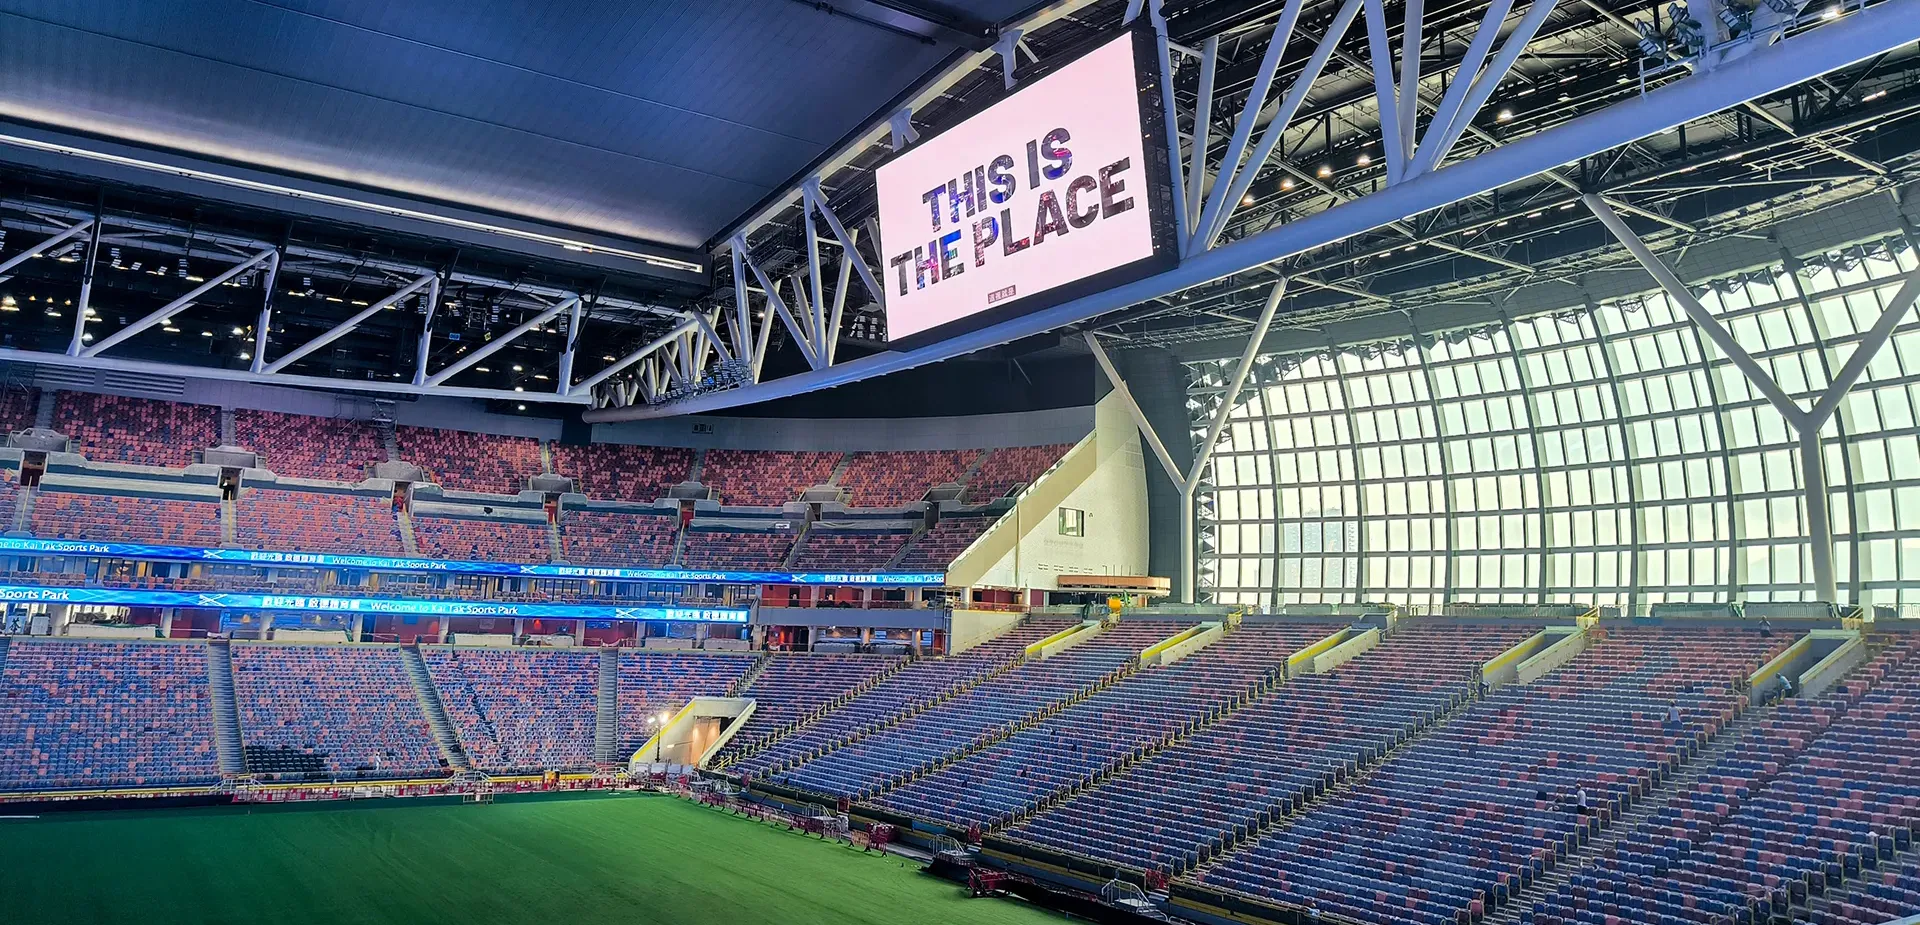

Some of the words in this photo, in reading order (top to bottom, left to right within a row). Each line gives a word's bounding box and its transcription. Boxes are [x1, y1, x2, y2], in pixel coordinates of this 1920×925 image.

[922, 154, 1016, 233] THIS
[1026, 127, 1073, 190] IS
[890, 229, 965, 297] THE
[972, 156, 1134, 268] PLACE
[11, 541, 21, 549] to
[24, 541, 38, 549] Kai
[41, 543, 55, 551] Tak
[56, 544, 87, 553] Sports
[89, 545, 109, 553] Park
[333, 557, 368, 566] Welcome
[392, 560, 404, 568] Tak
[405, 561, 429, 570] Sports
[430, 562, 447, 570] Park
[627, 570, 656, 579] Welcome
[0, 589, 39, 600] Sports
[42, 590, 70, 601] Park
[371, 602, 416, 612] Welcome
[420, 604, 429, 612] to
[432, 604, 446, 613] Kai
[449, 605, 466, 614] Tak
[467, 605, 496, 615] Sports
[498, 606, 518, 615] Park
